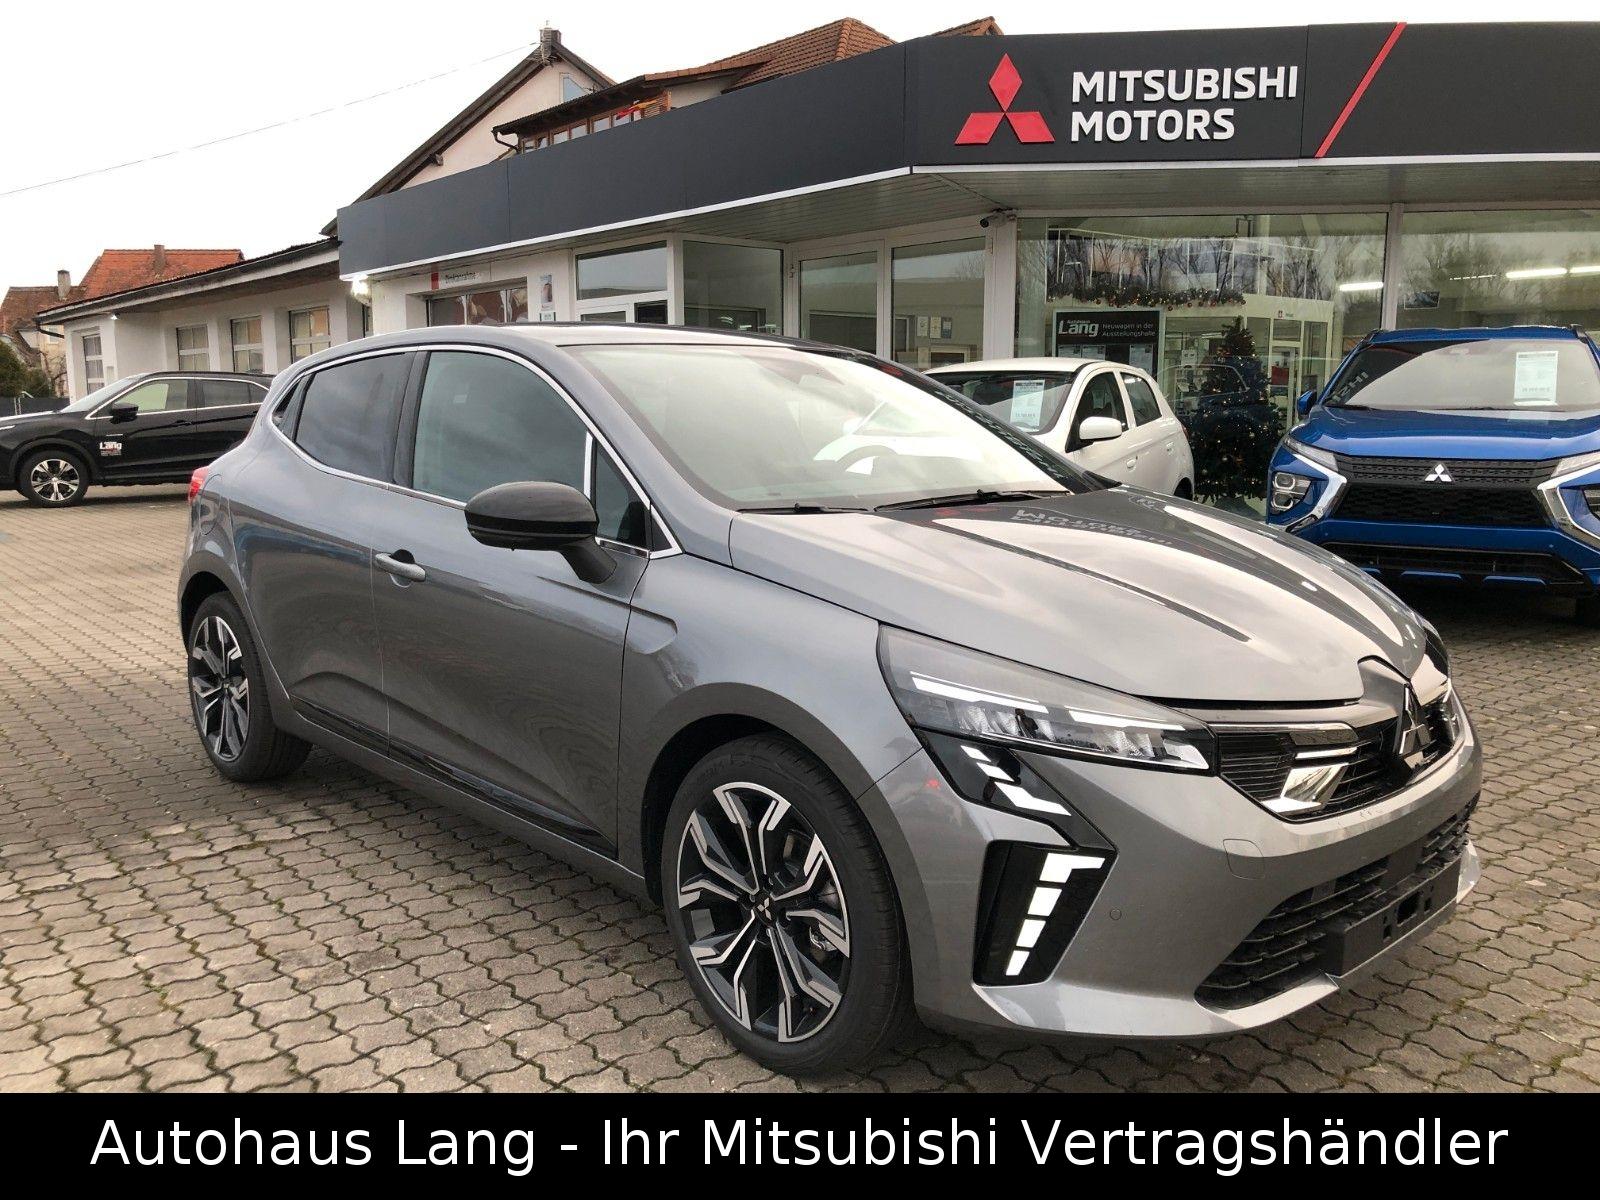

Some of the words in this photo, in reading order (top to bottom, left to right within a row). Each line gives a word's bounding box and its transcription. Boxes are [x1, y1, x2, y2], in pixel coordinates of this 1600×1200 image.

[1072, 66, 1298, 103] MITSUBISHI
[1071, 108, 1235, 142] MOTORS
[1058, 320, 1100, 337] Lang
[99, 441, 122, 451] Lang
